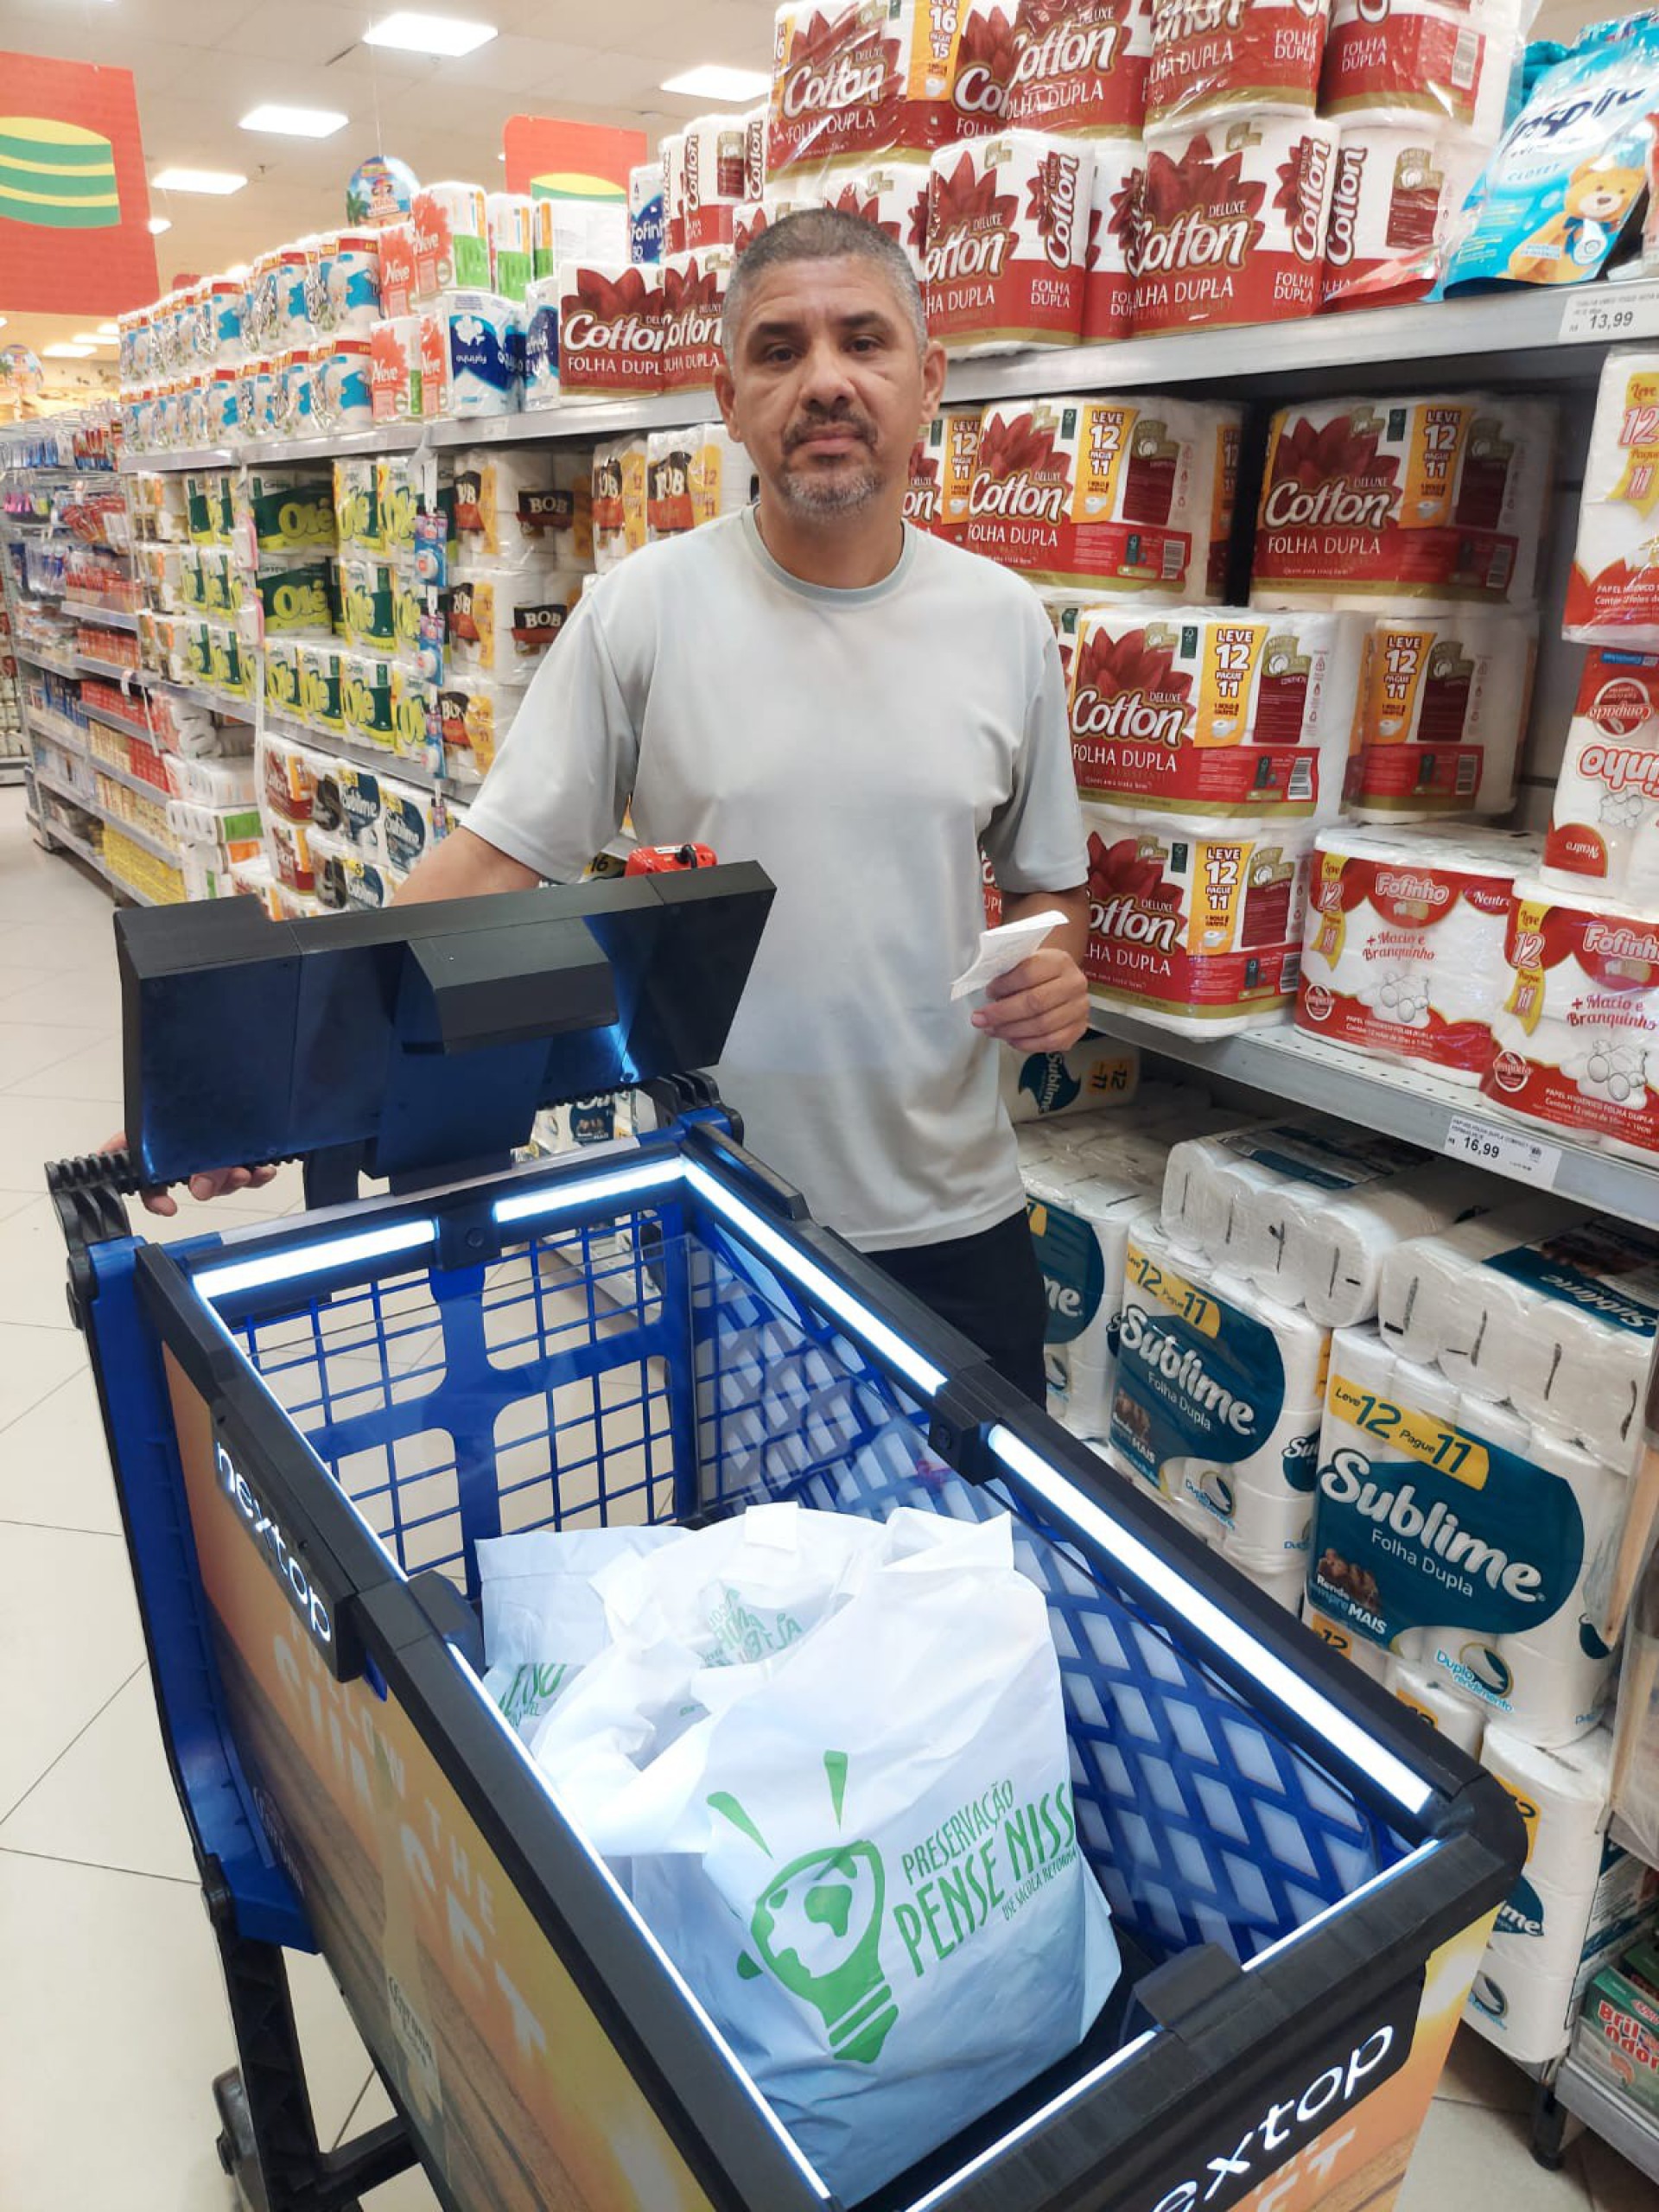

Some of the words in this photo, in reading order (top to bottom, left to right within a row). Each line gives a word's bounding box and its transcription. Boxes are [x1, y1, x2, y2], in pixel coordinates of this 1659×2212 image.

[930, 9, 957, 34] 16
[933, 42, 950, 58] 15
[1275, 29, 1318, 48] FOLHA
[1343, 36, 1388, 57] FOLHA
[1180, 40, 1234, 74] DUPLA
[1274, 45, 1316, 64] DUPLA
[1342, 53, 1388, 73] DUPLA
[784, 59, 886, 118] Cotton
[1007, 87, 1042, 119] OLHA
[1048, 79, 1104, 108] DUPLA
[827, 110, 877, 134] DUPLA
[1047, 154, 1079, 269] Cotton
[1209, 200, 1247, 217] DELUXE
[1294, 138, 1331, 262] Cotton
[1326, 147, 1367, 266] Cotton
[926, 225, 1006, 281] otton
[1032, 279, 1071, 295] FOLHA
[1174, 276, 1234, 303] DUPLA
[1275, 272, 1314, 289] FOLHA
[948, 284, 995, 312] DUPLA
[1031, 291, 1070, 308] DUPLA
[1274, 287, 1313, 304] DUPLA
[1589, 311, 1634, 331] 13,99
[568, 356, 616, 373] FOLHA
[622, 358, 664, 376] DUPL
[1092, 410, 1124, 424] LEVE
[1426, 410, 1461, 424] LEVE
[1618, 404, 1659, 447] 12
[951, 432, 978, 456] 12
[1090, 424, 1120, 450] 12
[1424, 425, 1456, 451] 12
[954, 465, 969, 480] 11
[1091, 461, 1111, 476] 11
[1426, 461, 1449, 479] 11
[529, 497, 568, 514] BOB
[969, 471, 1063, 522] Cotton
[1265, 480, 1391, 527] Cotton
[1010, 526, 1058, 548] DUPLA
[1268, 537, 1319, 554] FOLHA
[1324, 537, 1382, 555] DUPLA
[524, 611, 562, 627] BOB
[1217, 629, 1254, 643] LEVE
[1388, 635, 1421, 648] LEVE
[1216, 643, 1250, 671] 12
[1385, 649, 1418, 675] 12
[1150, 691, 1182, 704] DELUXE
[1218, 681, 1239, 698] 11
[1387, 683, 1406, 699] 11
[1072, 690, 1185, 747] Cotton
[1073, 743, 1116, 766] FOLHA
[1122, 749, 1177, 772] DUPLA
[1207, 847, 1241, 860] LEVE
[1205, 861, 1238, 886] 12
[1319, 880, 1344, 912] 12
[1376, 872, 1450, 905] Fofinho
[1141, 898, 1173, 912] DELUXE
[1208, 895, 1228, 910] 11
[1089, 895, 1177, 953] otton
[1363, 947, 1434, 963] Branquinho
[1511, 931, 1545, 969] 12
[1116, 949, 1172, 977] DUPLA
[1586, 995, 1631, 1012] Macio
[1567, 1013, 1657, 1032] Branquinho
[1464, 1136, 1500, 1159] 16,99
[1137, 1258, 1162, 1297] 12
[1183, 1290, 1208, 1326] 11
[1119, 1304, 1255, 1436] Sublime
[1147, 1370, 1178, 1404] Folha
[1179, 1398, 1211, 1432] Dupla
[1335, 1387, 1362, 1408] Leve
[1355, 1395, 1402, 1440] 12
[1400, 1428, 1436, 1455] Pague
[1432, 1433, 1472, 1473] 11
[1319, 1450, 1544, 1603] Sublime
[215, 1438, 332, 1643] nextop
[1371, 1529, 1418, 1568] Folha
[1422, 1559, 1474, 1598] Dupla
[1317, 1574, 1351, 1601] Rende
[1347, 1602, 1388, 1636] MAIS
[1436, 1649, 1474, 1681] Duplo
[901, 1778, 1015, 1886] PRESERVAÇÃO
[893, 1839, 1006, 1979] PENSE
[1004, 1782, 1077, 1883] NISS
[1153, 2024, 1395, 2212] extop
